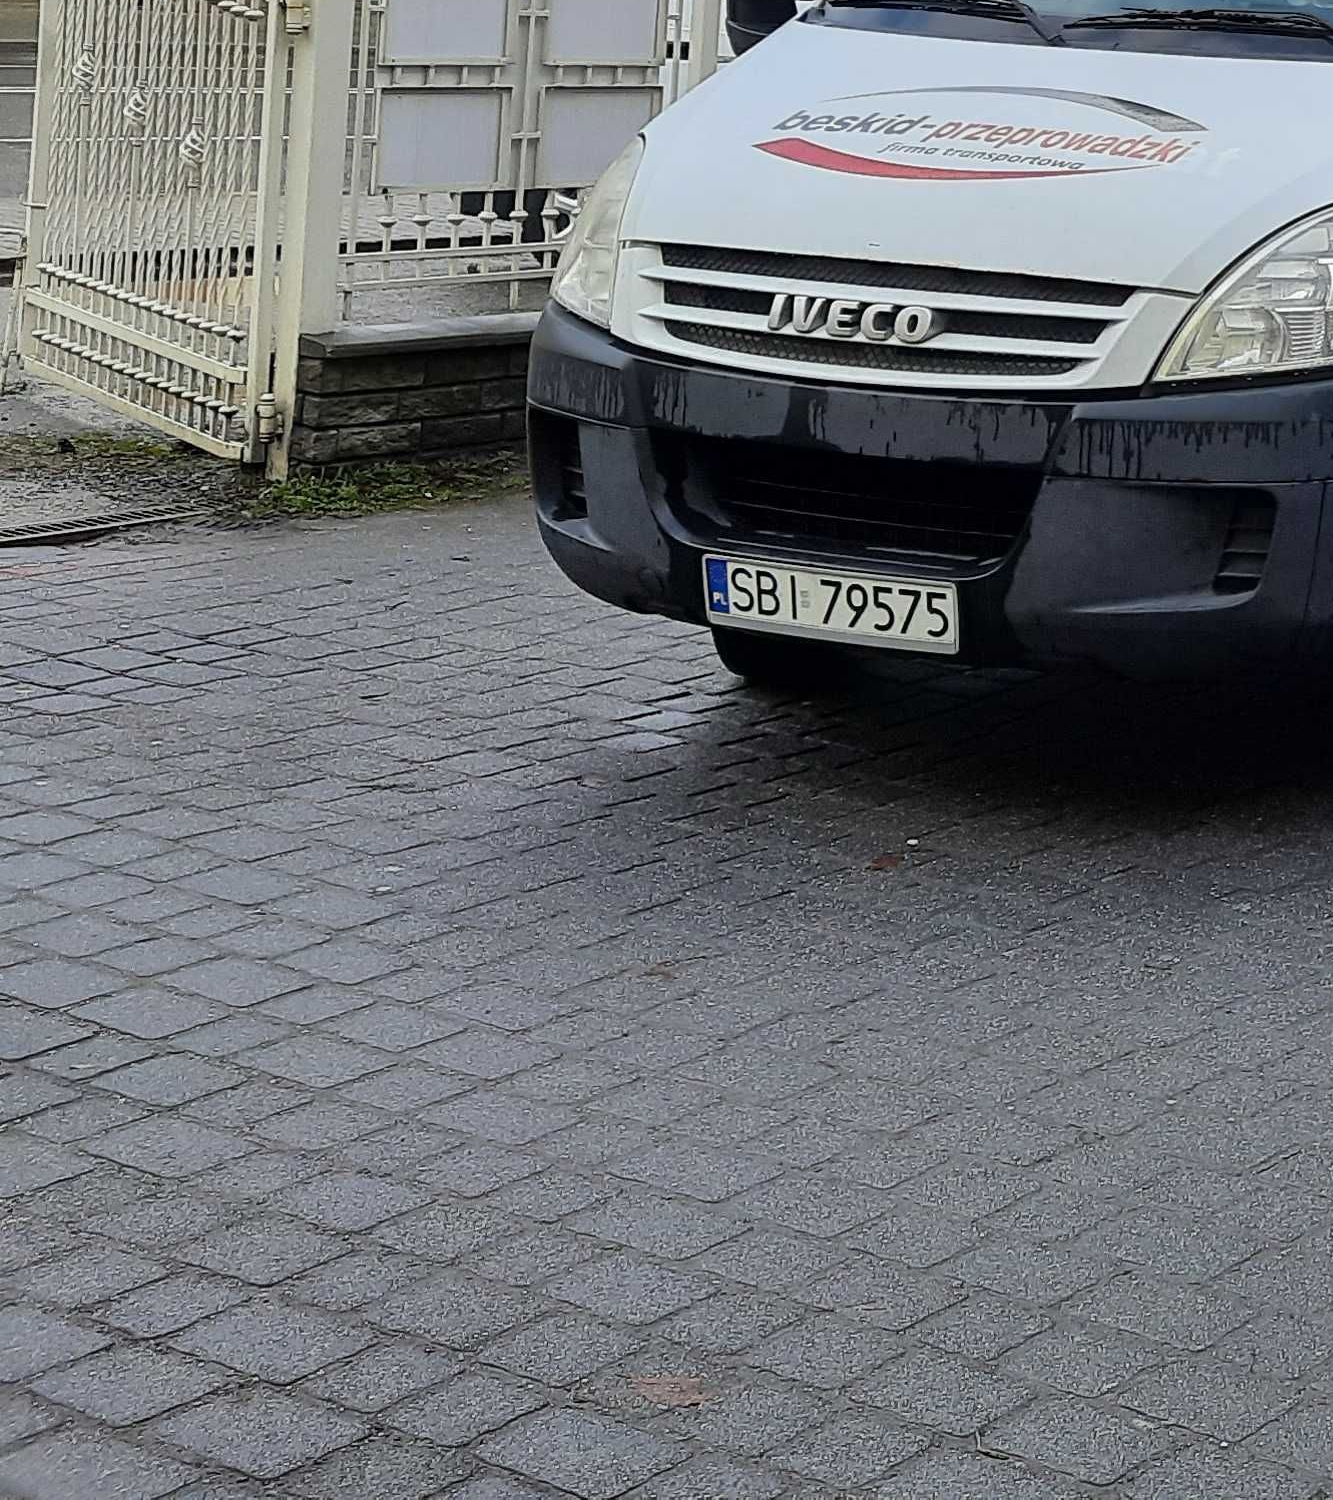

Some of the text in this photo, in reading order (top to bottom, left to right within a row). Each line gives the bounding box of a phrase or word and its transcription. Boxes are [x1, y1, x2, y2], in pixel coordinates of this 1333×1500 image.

[772, 109, 1201, 164] beskid-przeprowadzki
[877, 140, 1087, 171] firma transportowa
[768, 293, 937, 343] IVECO
[730, 567, 799, 621] SBI
[818, 578, 949, 638] 79575
